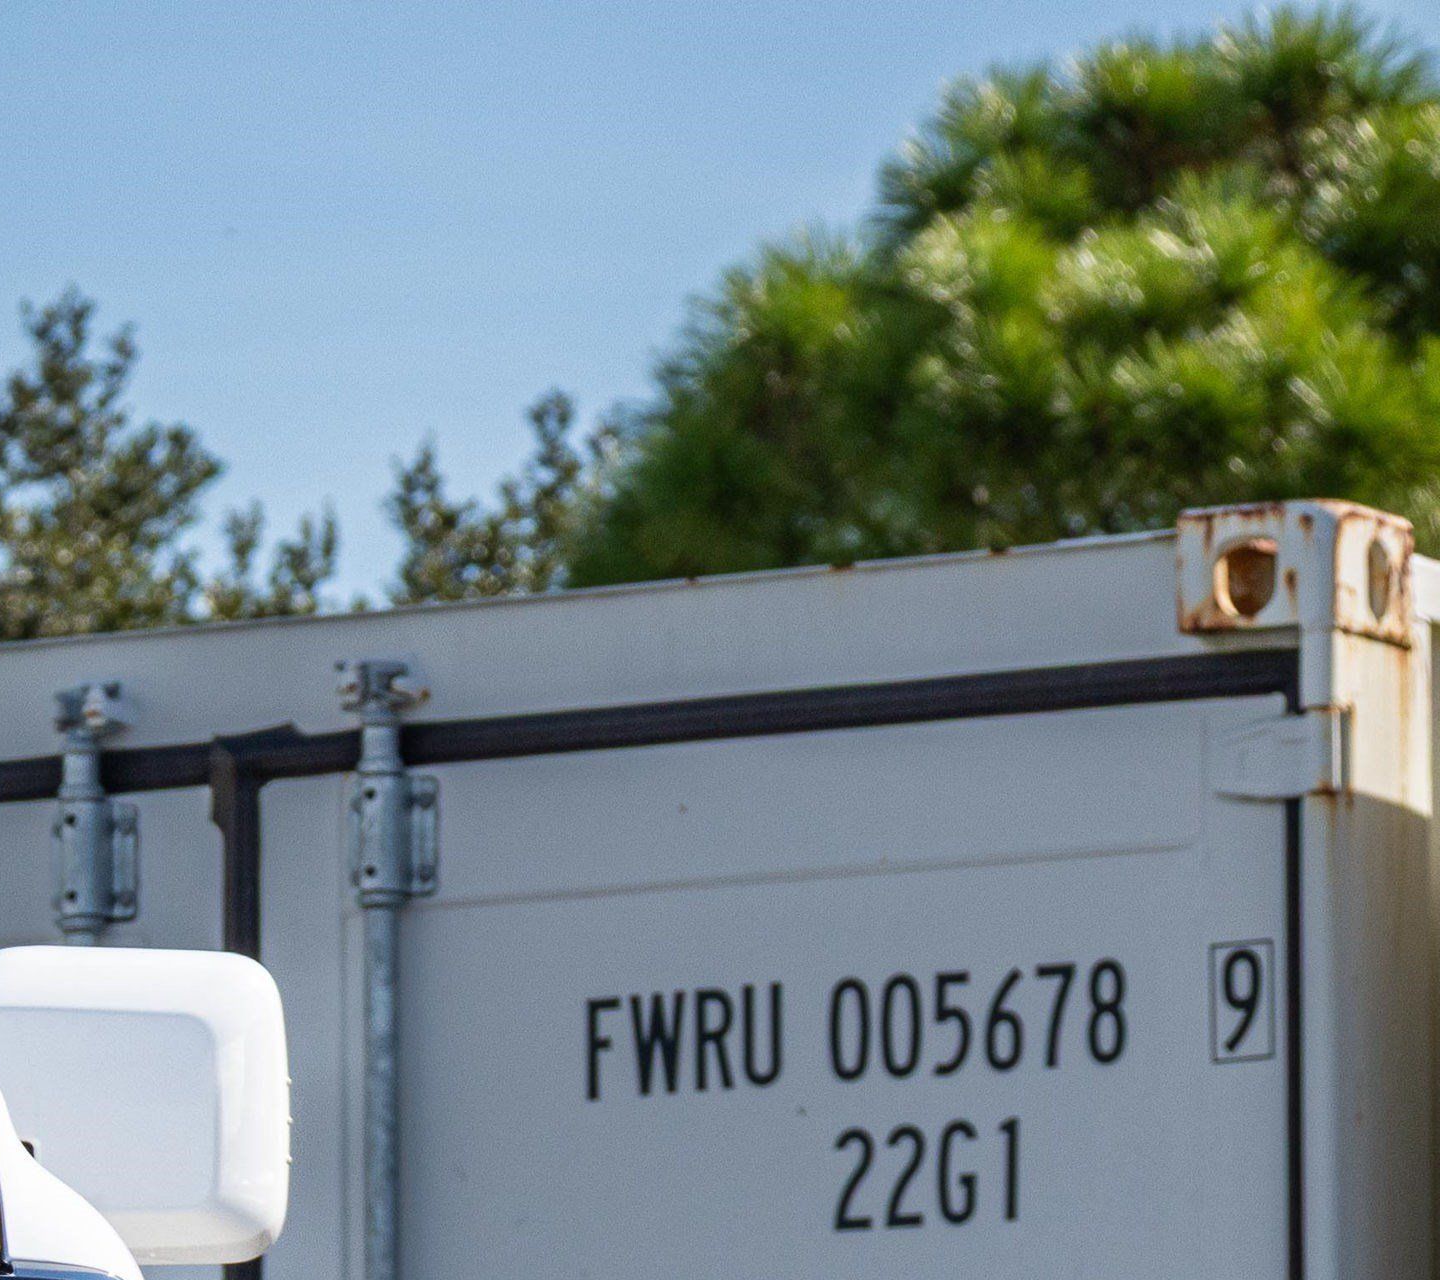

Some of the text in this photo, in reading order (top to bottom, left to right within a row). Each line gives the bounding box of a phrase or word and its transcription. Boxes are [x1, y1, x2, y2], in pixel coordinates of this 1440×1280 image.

[586, 947, 1262, 1100] FWRU 005678 9
[834, 1116, 1021, 1231] 22G1
